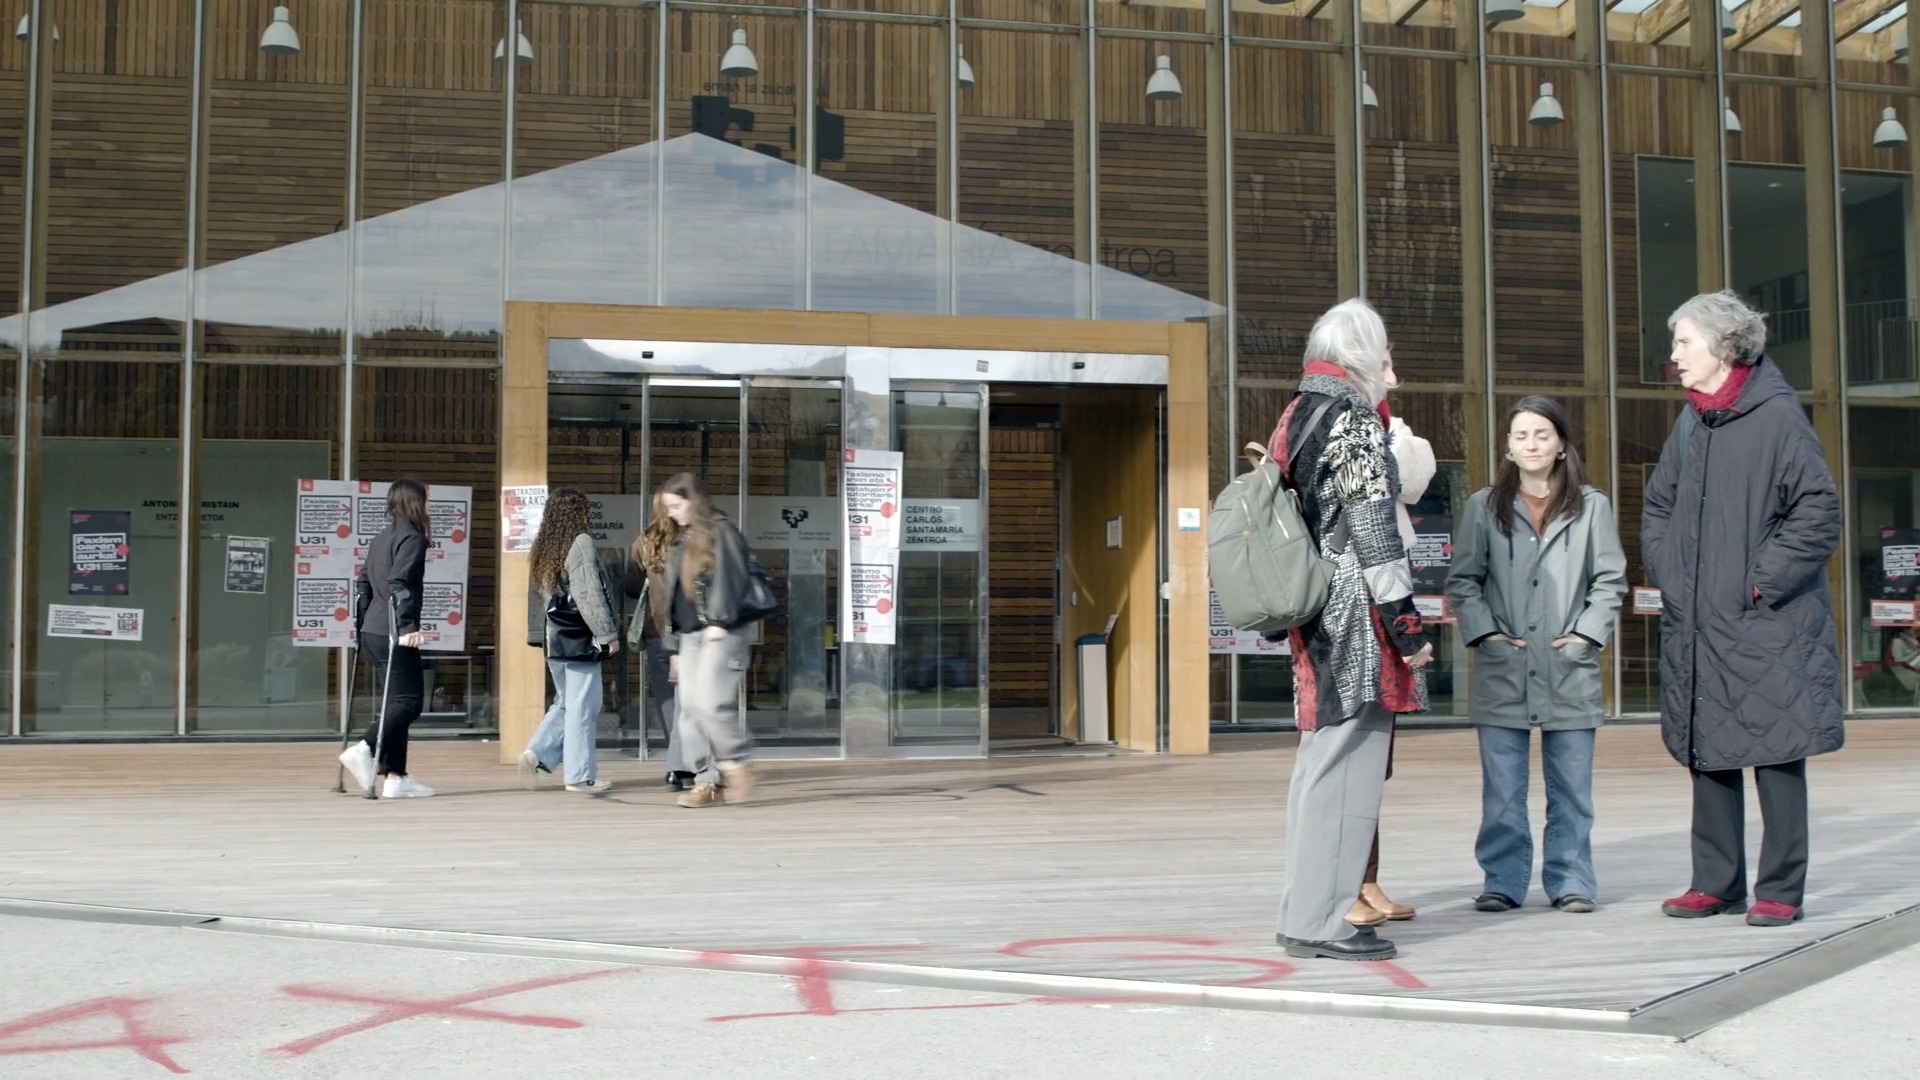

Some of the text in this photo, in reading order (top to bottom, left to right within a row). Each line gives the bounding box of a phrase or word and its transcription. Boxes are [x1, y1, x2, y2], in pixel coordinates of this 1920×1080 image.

[1028, 238, 1178, 278] zetroa
[905, 505, 943, 514] CENTRO
[849, 515, 869, 524] 31
[905, 515, 943, 524] CARLOS
[905, 524, 964, 534] SANTAMARÍA
[300, 536, 326, 544] U31
[905, 536, 948, 544] ZENTROA
[76, 563, 101, 571] U31
[298, 619, 324, 628] U31
